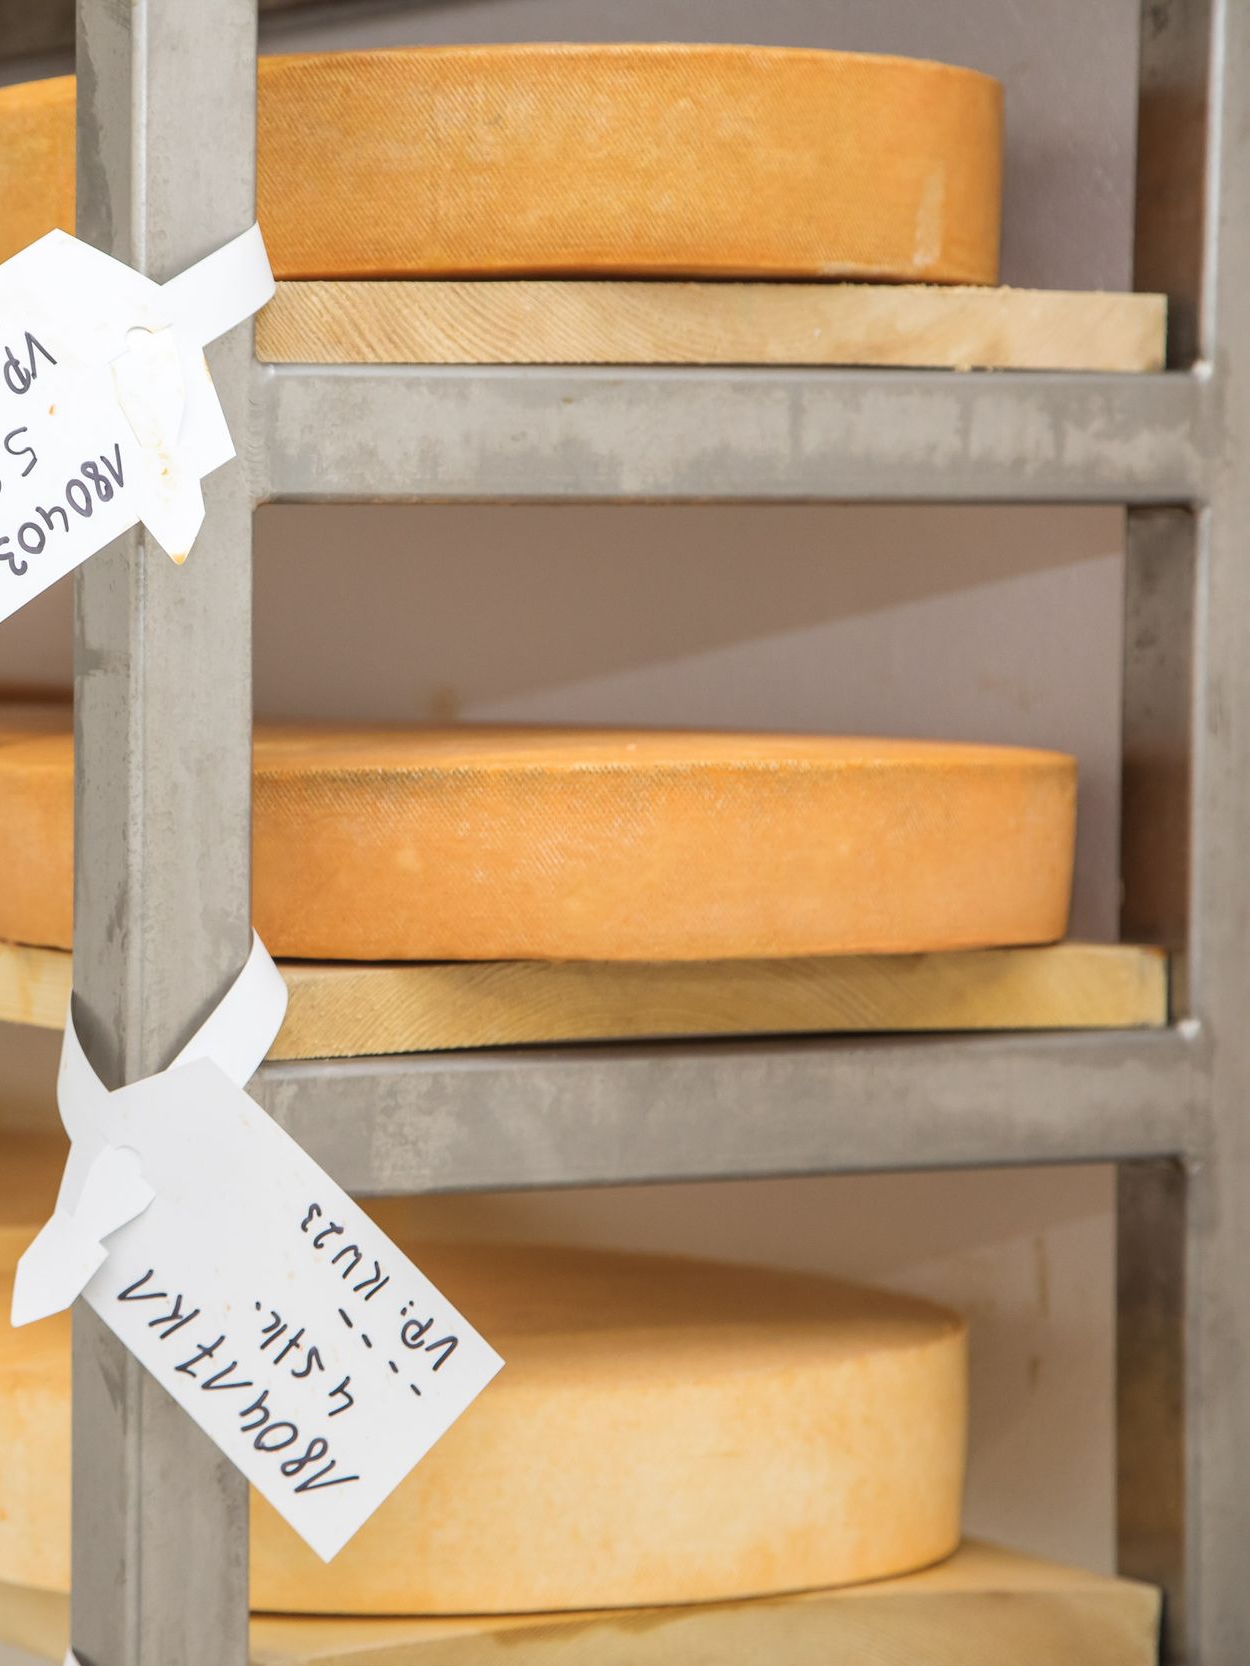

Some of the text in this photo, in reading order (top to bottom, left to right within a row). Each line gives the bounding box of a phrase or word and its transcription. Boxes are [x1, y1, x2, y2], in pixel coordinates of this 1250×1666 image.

[2, 425, 38, 478] 5
[115, 1268, 360, 1494] 180417 K1
[254, 1300, 354, 1417] 4 Stk.
[399, 1299, 459, 1372] VP:
